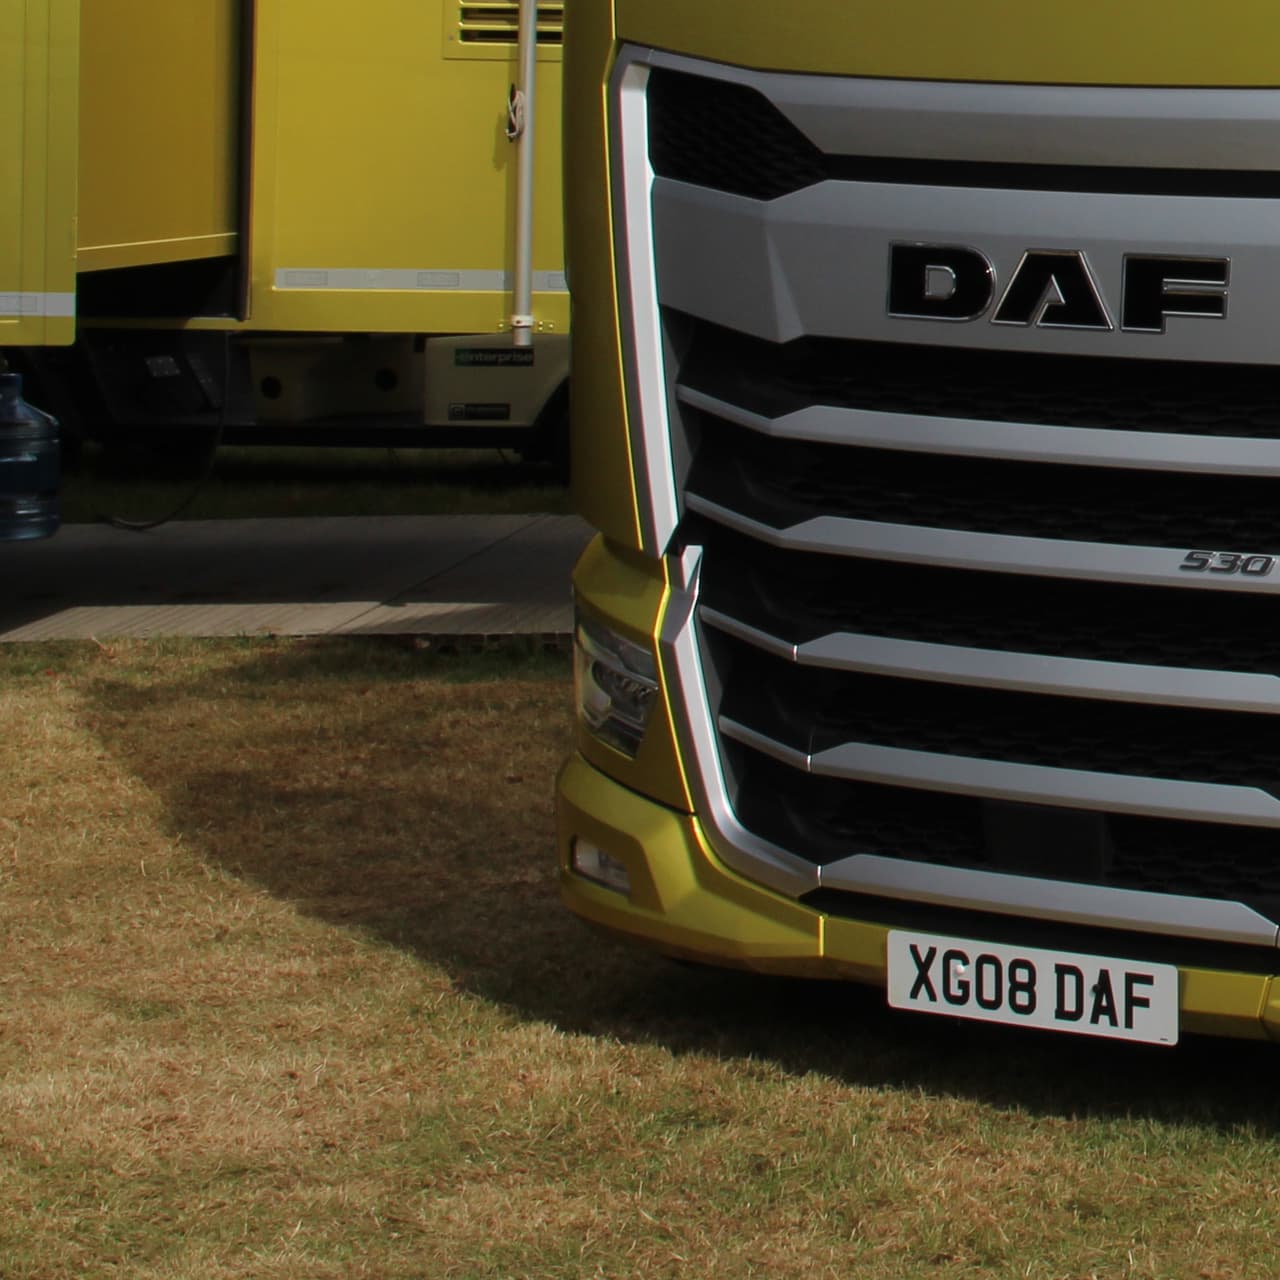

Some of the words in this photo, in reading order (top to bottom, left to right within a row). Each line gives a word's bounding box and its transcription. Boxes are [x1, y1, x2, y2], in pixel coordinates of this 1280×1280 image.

[888, 240, 1230, 334] DAF
[1178, 550, 1277, 577] 530
[909, 943, 1037, 1016] XG08
[1055, 963, 1154, 1030] DAF
